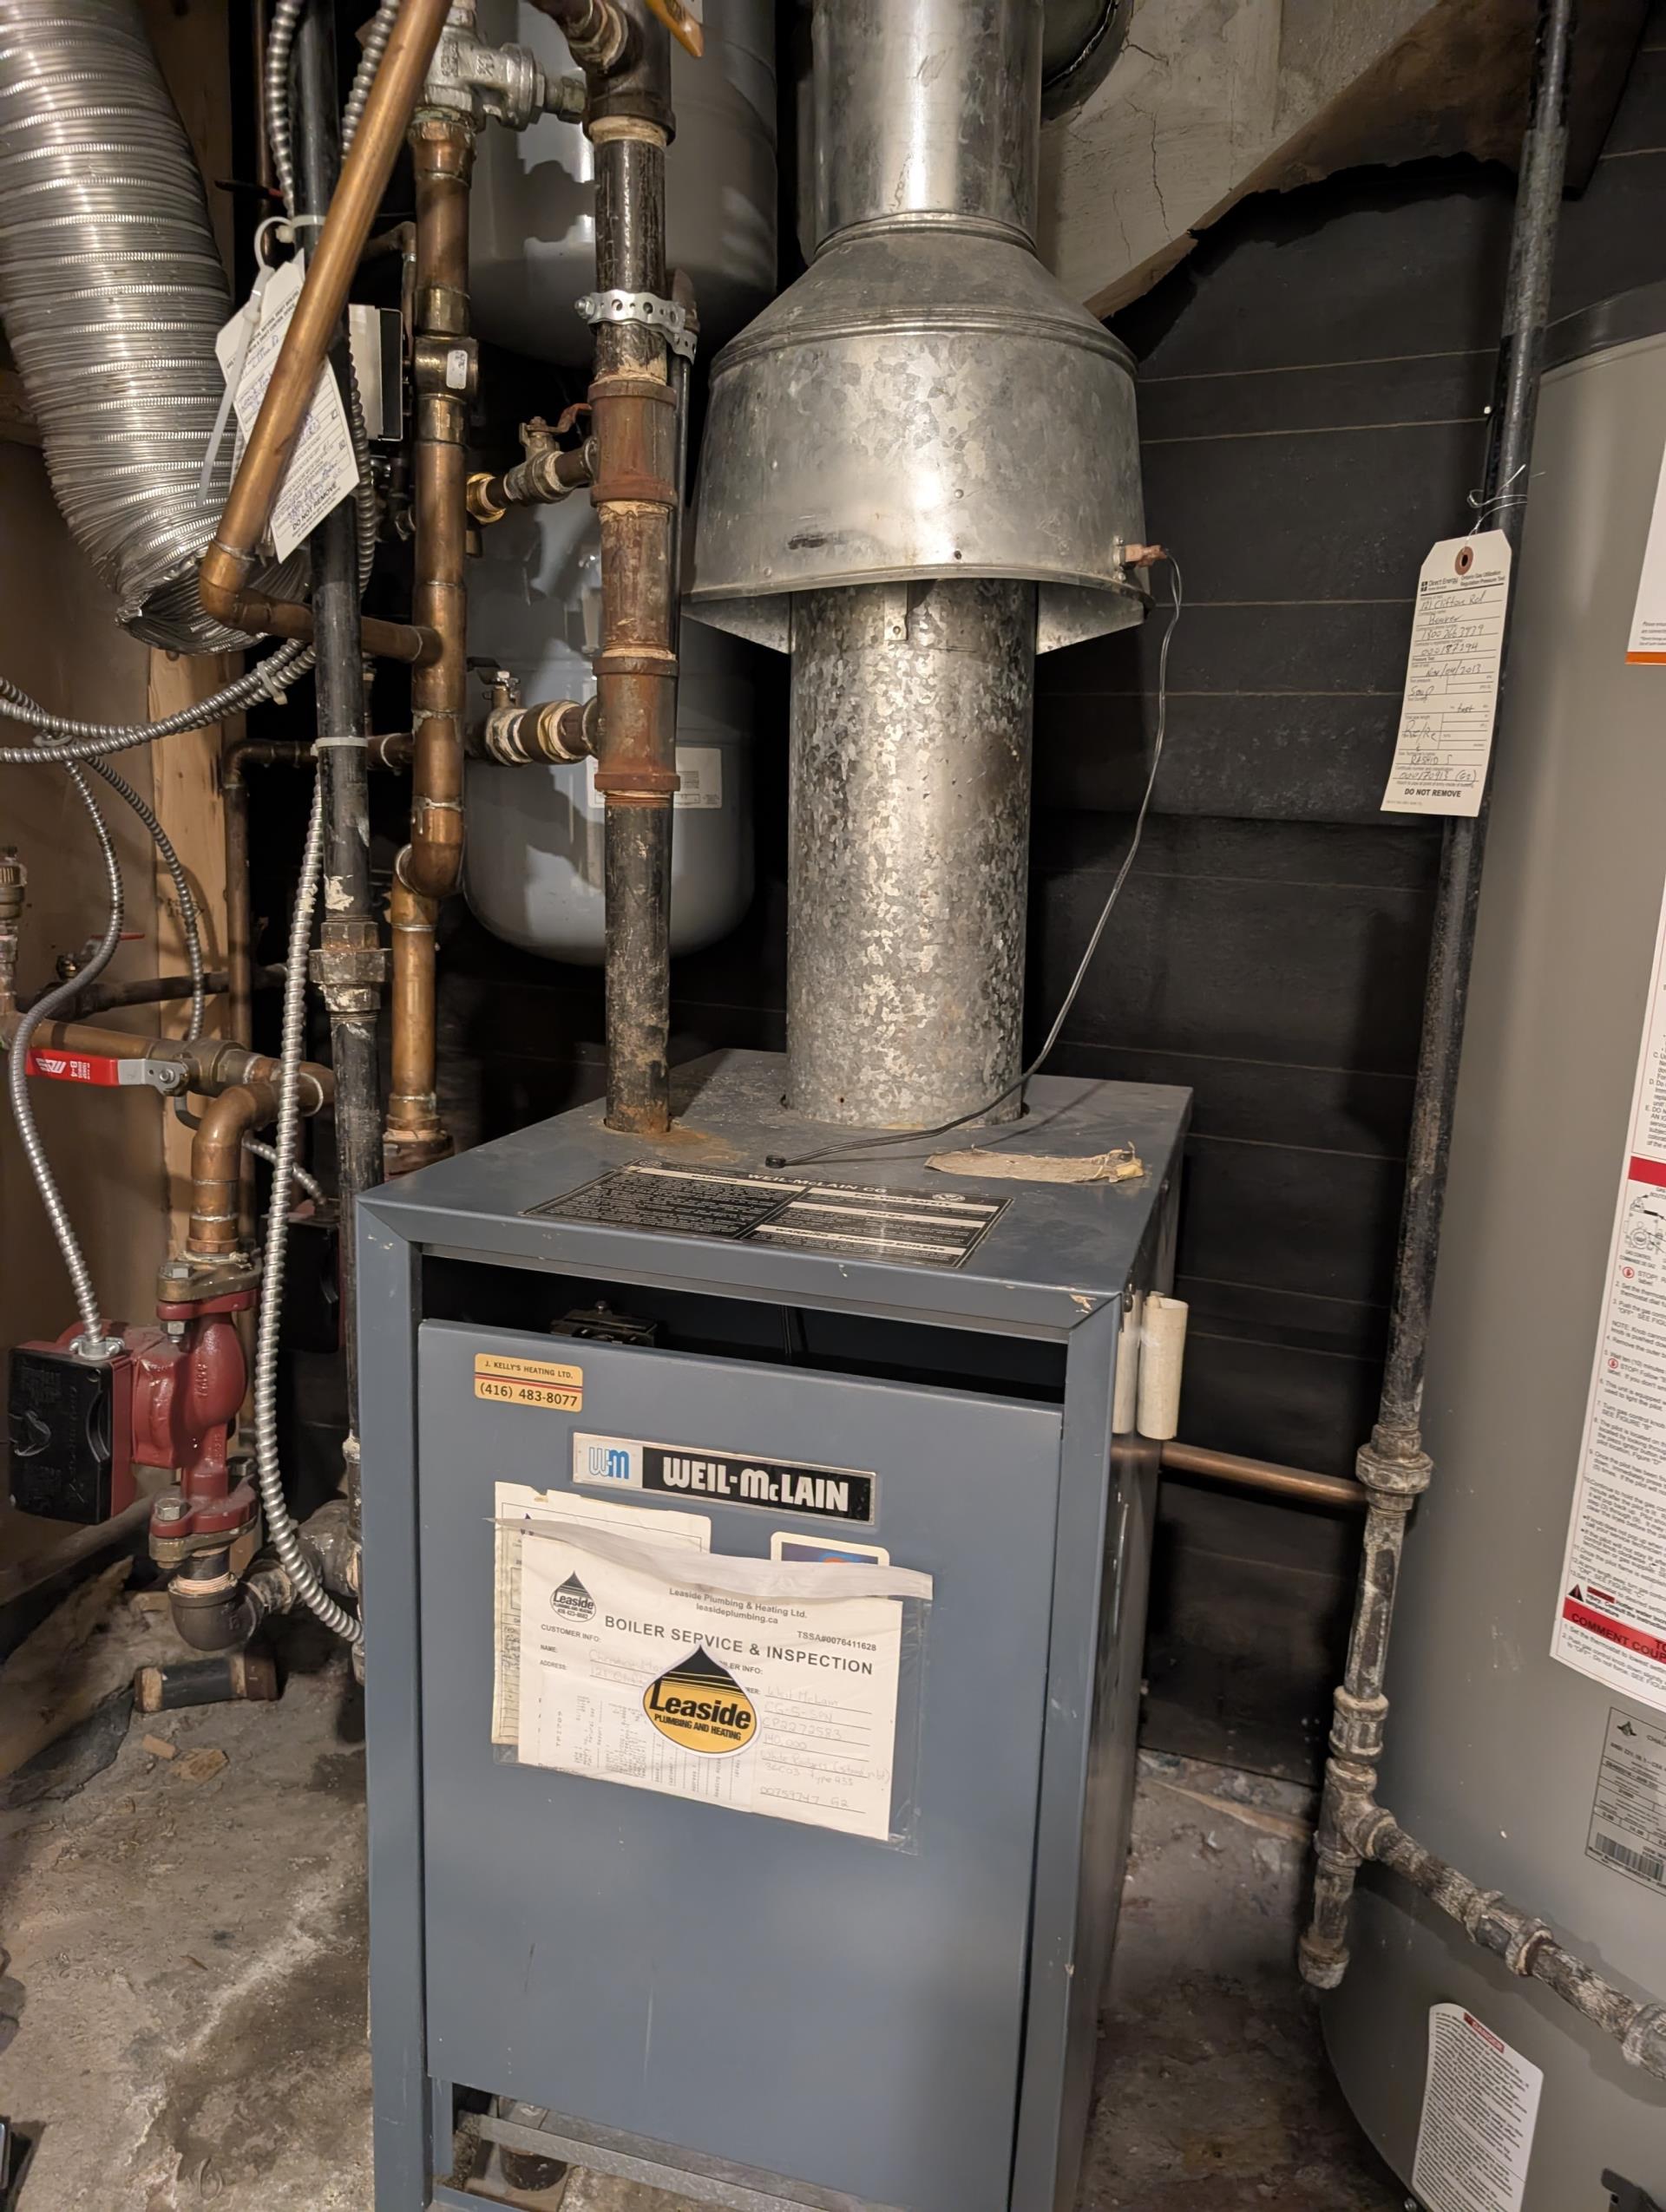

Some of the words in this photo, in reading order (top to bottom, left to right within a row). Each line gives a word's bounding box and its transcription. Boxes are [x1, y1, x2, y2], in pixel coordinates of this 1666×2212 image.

[1432, 789, 1461, 798] REMOVE
[748, 1174, 857, 1190] WEIL-McLAIN
[484, 1359, 491, 1368] J.
[493, 1361, 521, 1372] KELLY'S
[523, 1365, 555, 1377] HEATING
[558, 1370, 573, 1379] LTD.
[479, 1383, 513, 1399] (416)
[518, 1388, 578, 1407] 483-8077
[663, 1456, 849, 1512] WEIL-McLAIN
[553, 1591, 594, 1611] Leaside
[669, 1588, 702, 1601] Leaside
[704, 1594, 744, 1610] Plumbing
[745, 1601, 752, 1610] &
[755, 1602, 789, 1616] Heating
[790, 1609, 807, 1620] Ltd.
[696, 1603, 778, 1624] leasideplumbing.ca
[541, 1623, 580, 1639] CUSTOMER
[582, 1633, 600, 1642] INFO:
[1571, 1613, 1630, 1646] COMMENT
[540, 1644, 558, 1653] NAME:
[605, 1614, 665, 1639] BOILER
[671, 1627, 743, 1652] SERVICE
[749, 1643, 761, 1656] &
[766, 1646, 873, 1675] INSPECTION
[797, 1630, 877, 1652] TSSA#0076411628
[540, 1659, 567, 1671] ADDRESS:
[742, 1666, 764, 1675] INFO:
[649, 1681, 751, 1730] Leaside
[654, 1713, 692, 1729] PLUMBING
[693, 1722, 710, 1732] AND
[711, 1725, 742, 1741] HEATING
